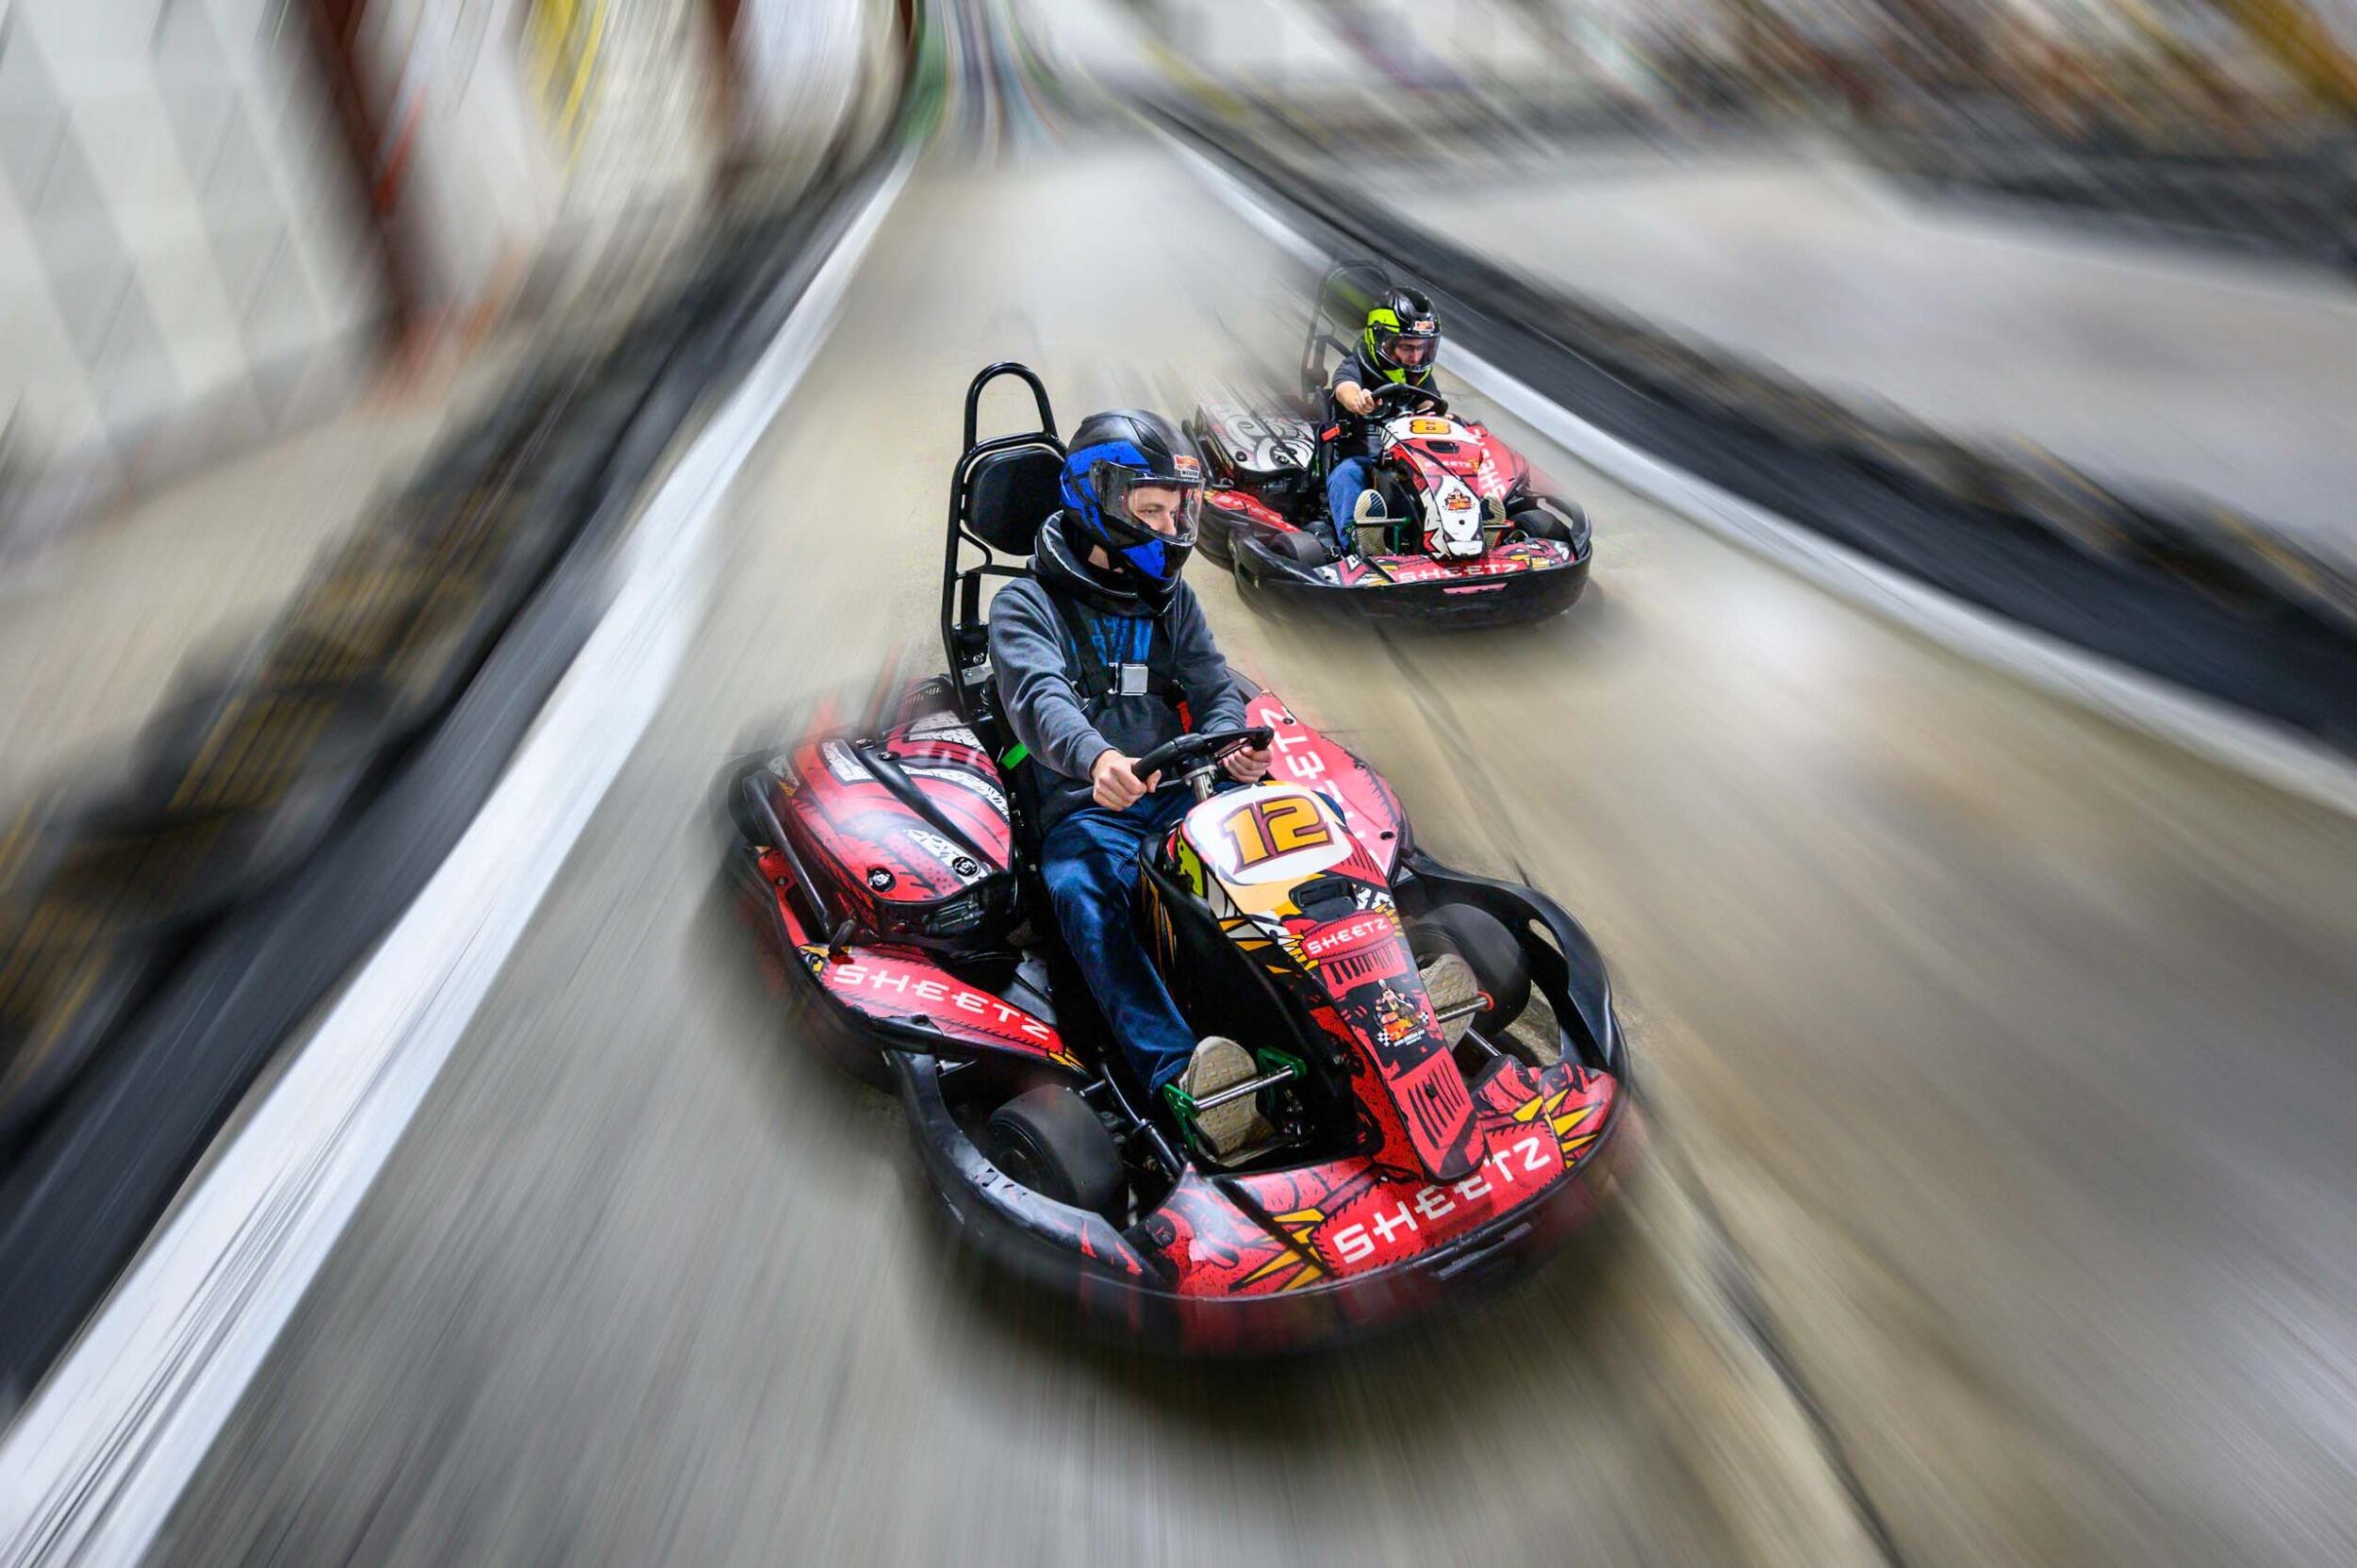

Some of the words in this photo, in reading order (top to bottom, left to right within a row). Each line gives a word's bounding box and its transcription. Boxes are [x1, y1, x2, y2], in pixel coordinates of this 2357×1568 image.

[1409, 419, 1451, 435] 8
[1398, 563, 1519, 583] SHEETZ
[1260, 707, 1387, 875] ETZ
[1219, 795, 1334, 874] 12
[1307, 917, 1388, 954] SHEETZ
[833, 964, 1050, 1041] SHEETZ
[1332, 1136, 1552, 1264] SHEETZ
